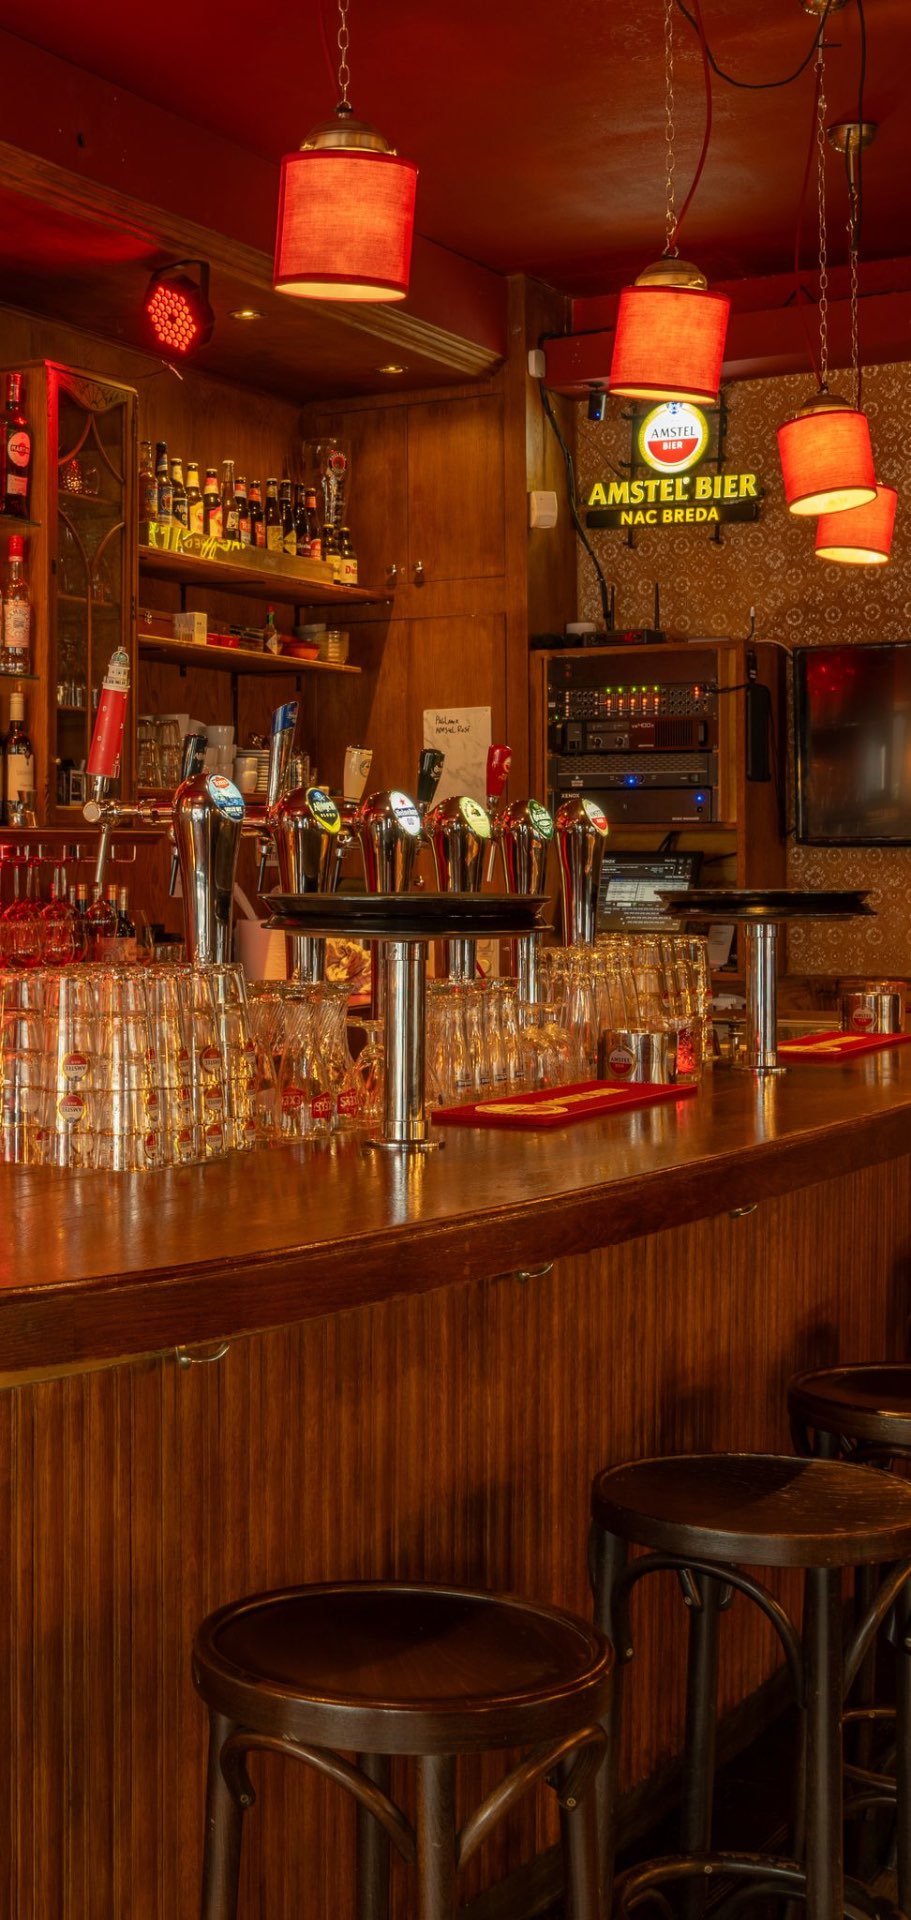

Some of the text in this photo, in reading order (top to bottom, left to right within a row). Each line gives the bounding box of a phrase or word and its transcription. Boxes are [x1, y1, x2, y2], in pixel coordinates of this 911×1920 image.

[651, 426, 696, 438] AMSTEL
[662, 440, 683, 450] BIER
[695, 474, 757, 499] BIER
[620, 506, 720, 525] NAC BREDA
